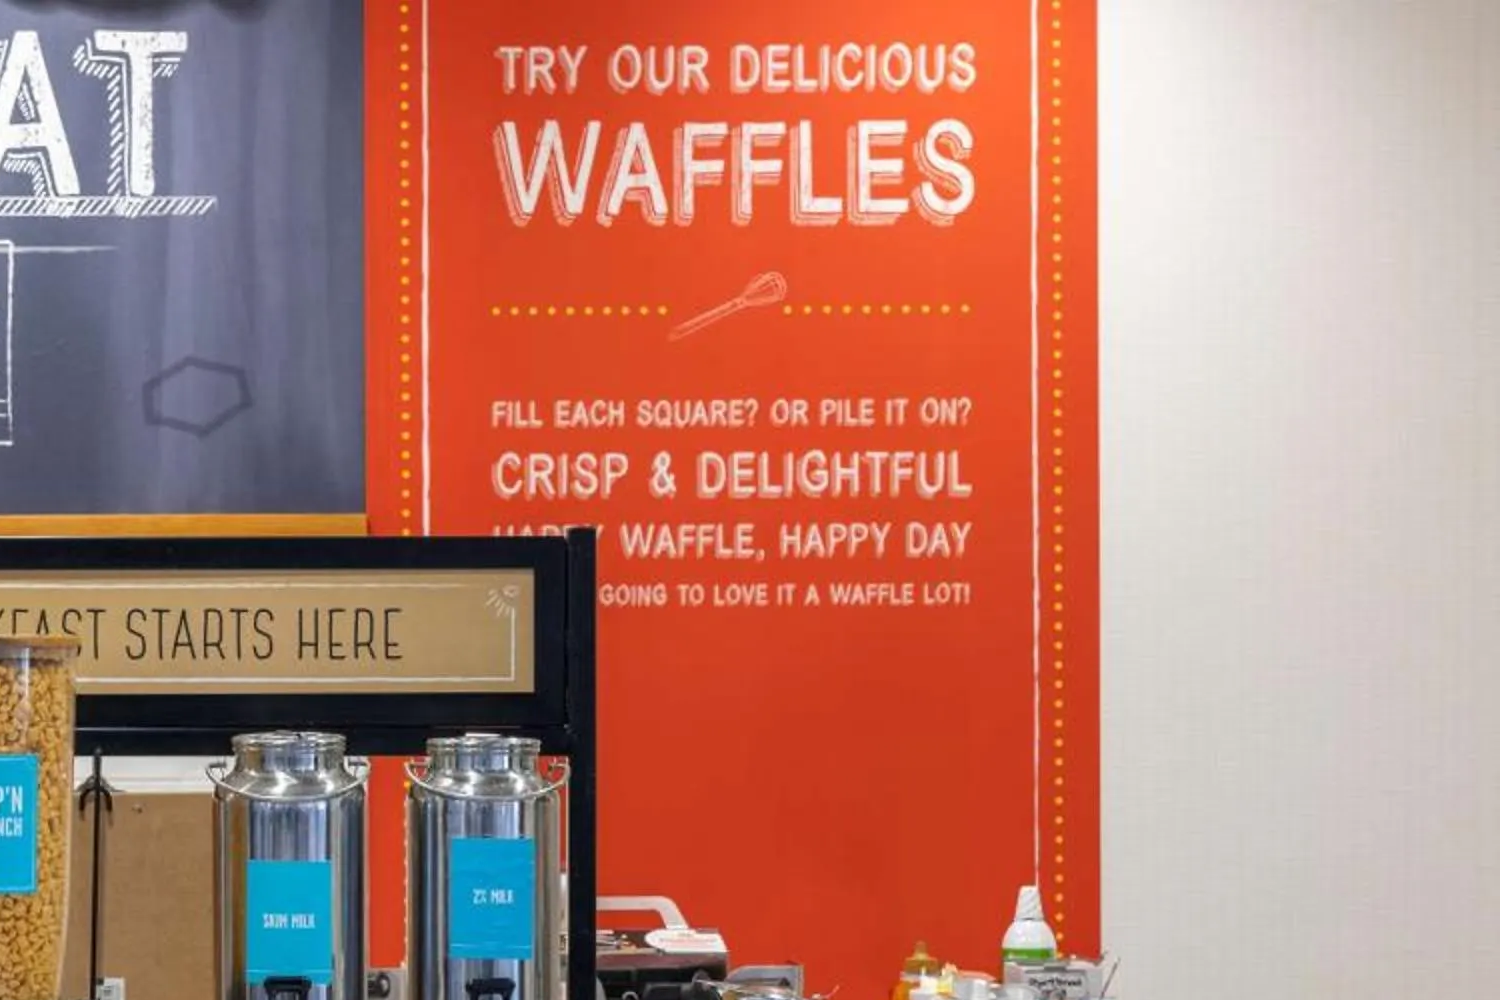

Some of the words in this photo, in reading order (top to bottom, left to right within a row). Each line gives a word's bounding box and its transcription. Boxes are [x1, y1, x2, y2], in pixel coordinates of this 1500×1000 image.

[495, 45, 588, 95] TRY
[609, 44, 710, 95] OUR
[731, 42, 977, 95] DELICIOUS
[494, 118, 976, 227] WAFFLES
[492, 399, 544, 428] FILL
[554, 399, 625, 428] EACH
[637, 398, 758, 428] SQUARE?
[770, 398, 809, 427] OR
[820, 398, 875, 427] PILE
[885, 398, 909, 427] IT
[920, 397, 972, 427] ON?
[492, 451, 629, 500] CRISP
[651, 451, 677, 499] &
[697, 450, 973, 499] DELIGHTFUL
[620, 522, 765, 561] WAFFLE,
[779, 522, 891, 559] HAPPY
[906, 521, 972, 559] DAY
[599, 583, 668, 606] GOING
[677, 583, 704, 606] TO
[713, 583, 768, 606] LOVE
[777, 583, 796, 606] IT
[804, 583, 820, 606] A
[829, 582, 914, 606] WAFFLE
[923, 582, 971, 605] LOT!
[125, 607, 275, 661] STARTS
[297, 607, 404, 660] HERE
[491, 889, 514, 905] MILK
[263, 912, 288, 930] SKIM
[291, 912, 316, 930] MILK
